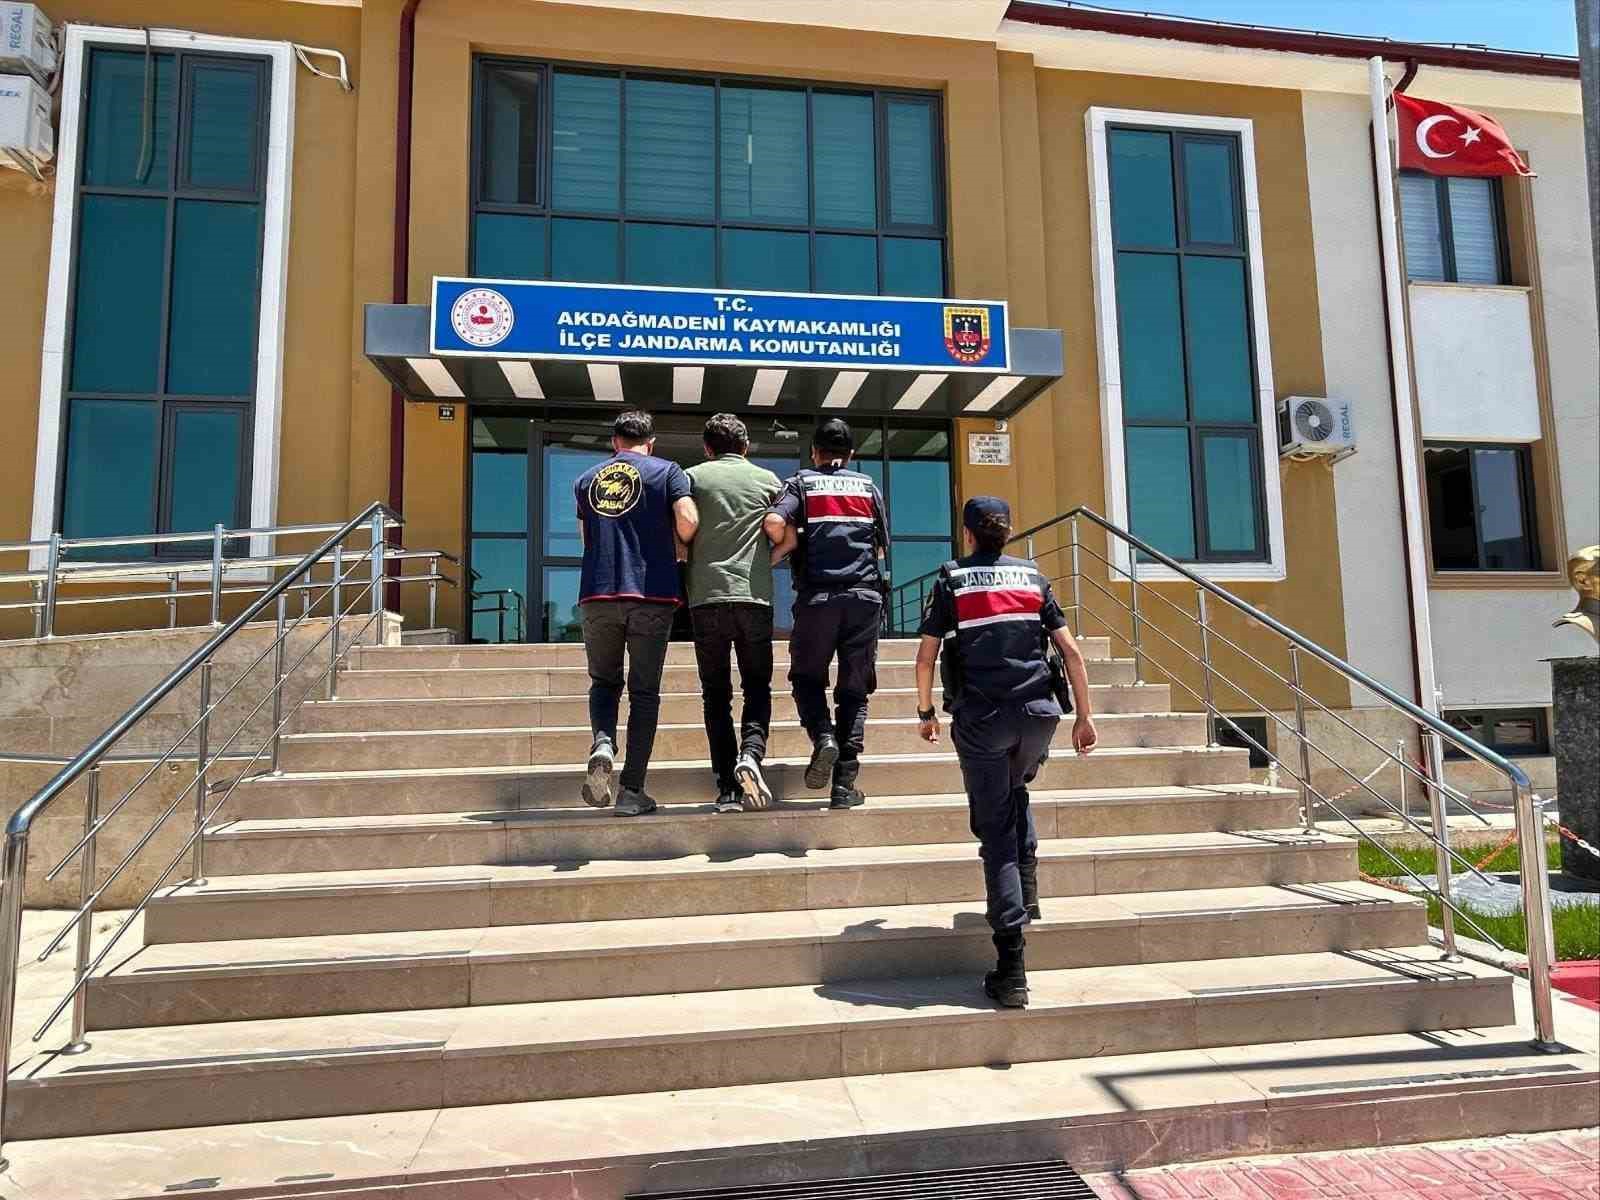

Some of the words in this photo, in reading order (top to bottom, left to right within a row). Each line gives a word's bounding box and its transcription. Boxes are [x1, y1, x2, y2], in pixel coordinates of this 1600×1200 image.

[9, 8, 24, 49] REGAL
[714, 297, 754, 312] T.C.
[557, 310, 726, 331] AKDAĞMADENİ
[733, 318, 901, 337] KAYMAKAMLIĞI
[560, 329, 612, 350] İLÇE
[618, 334, 743, 352] JANDARMA
[750, 339, 900, 357] KOMUTANLIĞI
[1340, 402, 1351, 439] REGAL
[813, 478, 866, 493] JANDARMA
[961, 569, 1031, 587] JANDARMA
